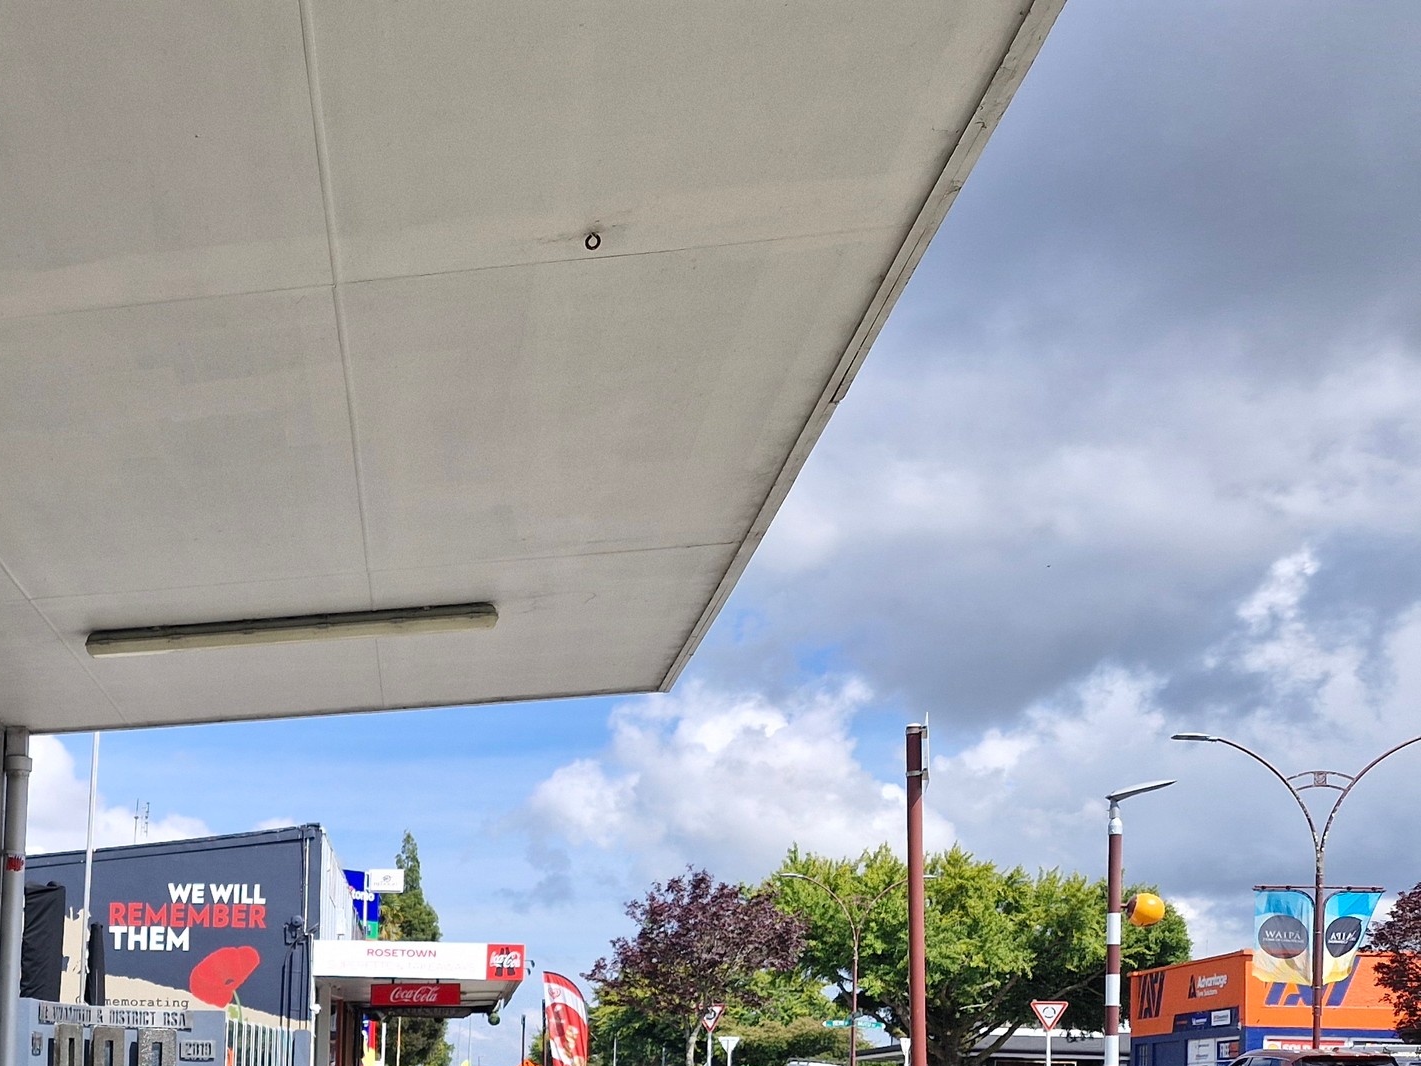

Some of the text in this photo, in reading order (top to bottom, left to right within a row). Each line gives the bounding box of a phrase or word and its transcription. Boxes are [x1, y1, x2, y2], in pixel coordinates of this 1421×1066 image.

[168, 883, 267, 905] WE WILL
[109, 902, 267, 928] REMEMBER
[109, 926, 190, 951] THEM
[366, 948, 437, 958] ROSETOWN
[1197, 973, 1228, 988] Advantage
[76, 996, 189, 1010] Cmemorating
[390, 986, 440, 1003] Coca-Cola
[109, 1009, 156, 1026] DISTRICT
[163, 1011, 186, 1027] RSA
